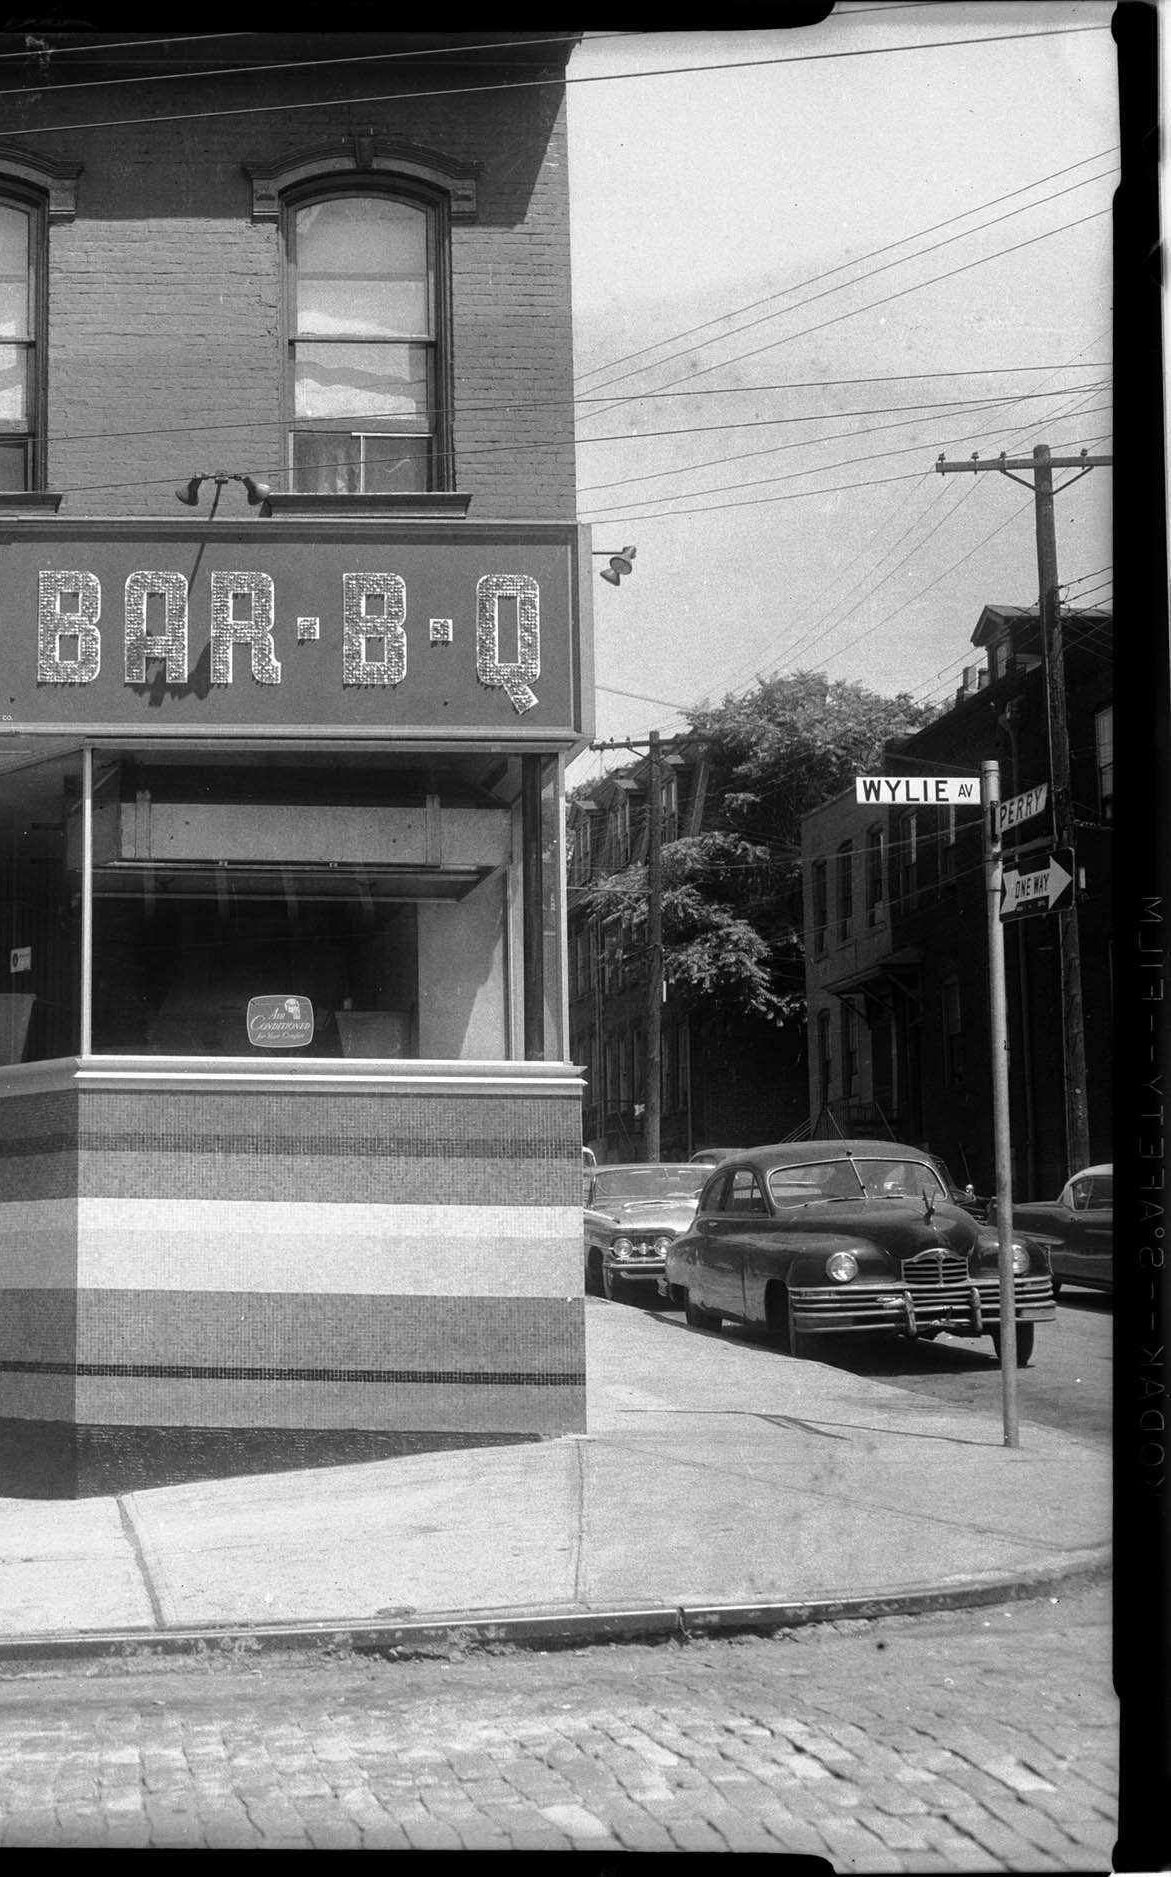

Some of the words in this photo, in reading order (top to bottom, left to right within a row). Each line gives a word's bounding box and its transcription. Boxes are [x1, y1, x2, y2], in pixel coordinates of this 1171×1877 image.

[862, 780, 949, 802] WYLIE
[958, 784, 973, 798] AV
[999, 788, 1043, 828] PERRY
[1015, 877, 1031, 898] ONE
[1033, 873, 1049, 895] WAY
